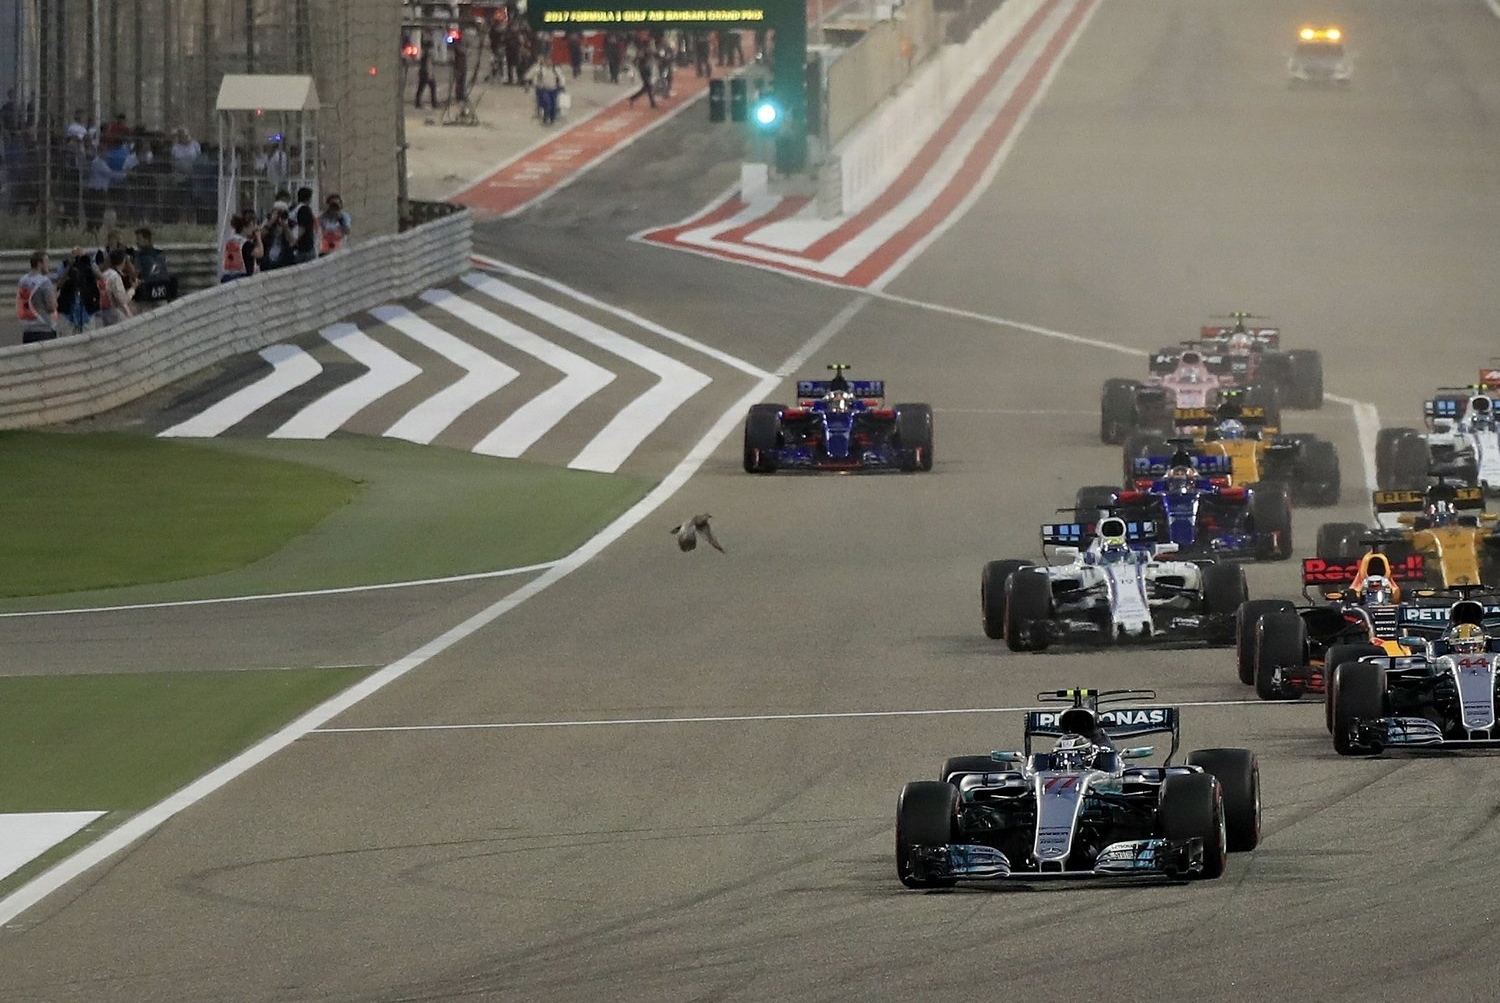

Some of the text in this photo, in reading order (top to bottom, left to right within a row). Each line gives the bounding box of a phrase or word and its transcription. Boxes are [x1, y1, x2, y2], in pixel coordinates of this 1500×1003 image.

[544, 10, 569, 22] 2017
[570, 10, 615, 22] FORMULA
[622, 10, 648, 22] GULF
[707, 10, 740, 21] GRAND
[1458, 657, 1490, 668] 44
[1044, 777, 1079, 789] 77
